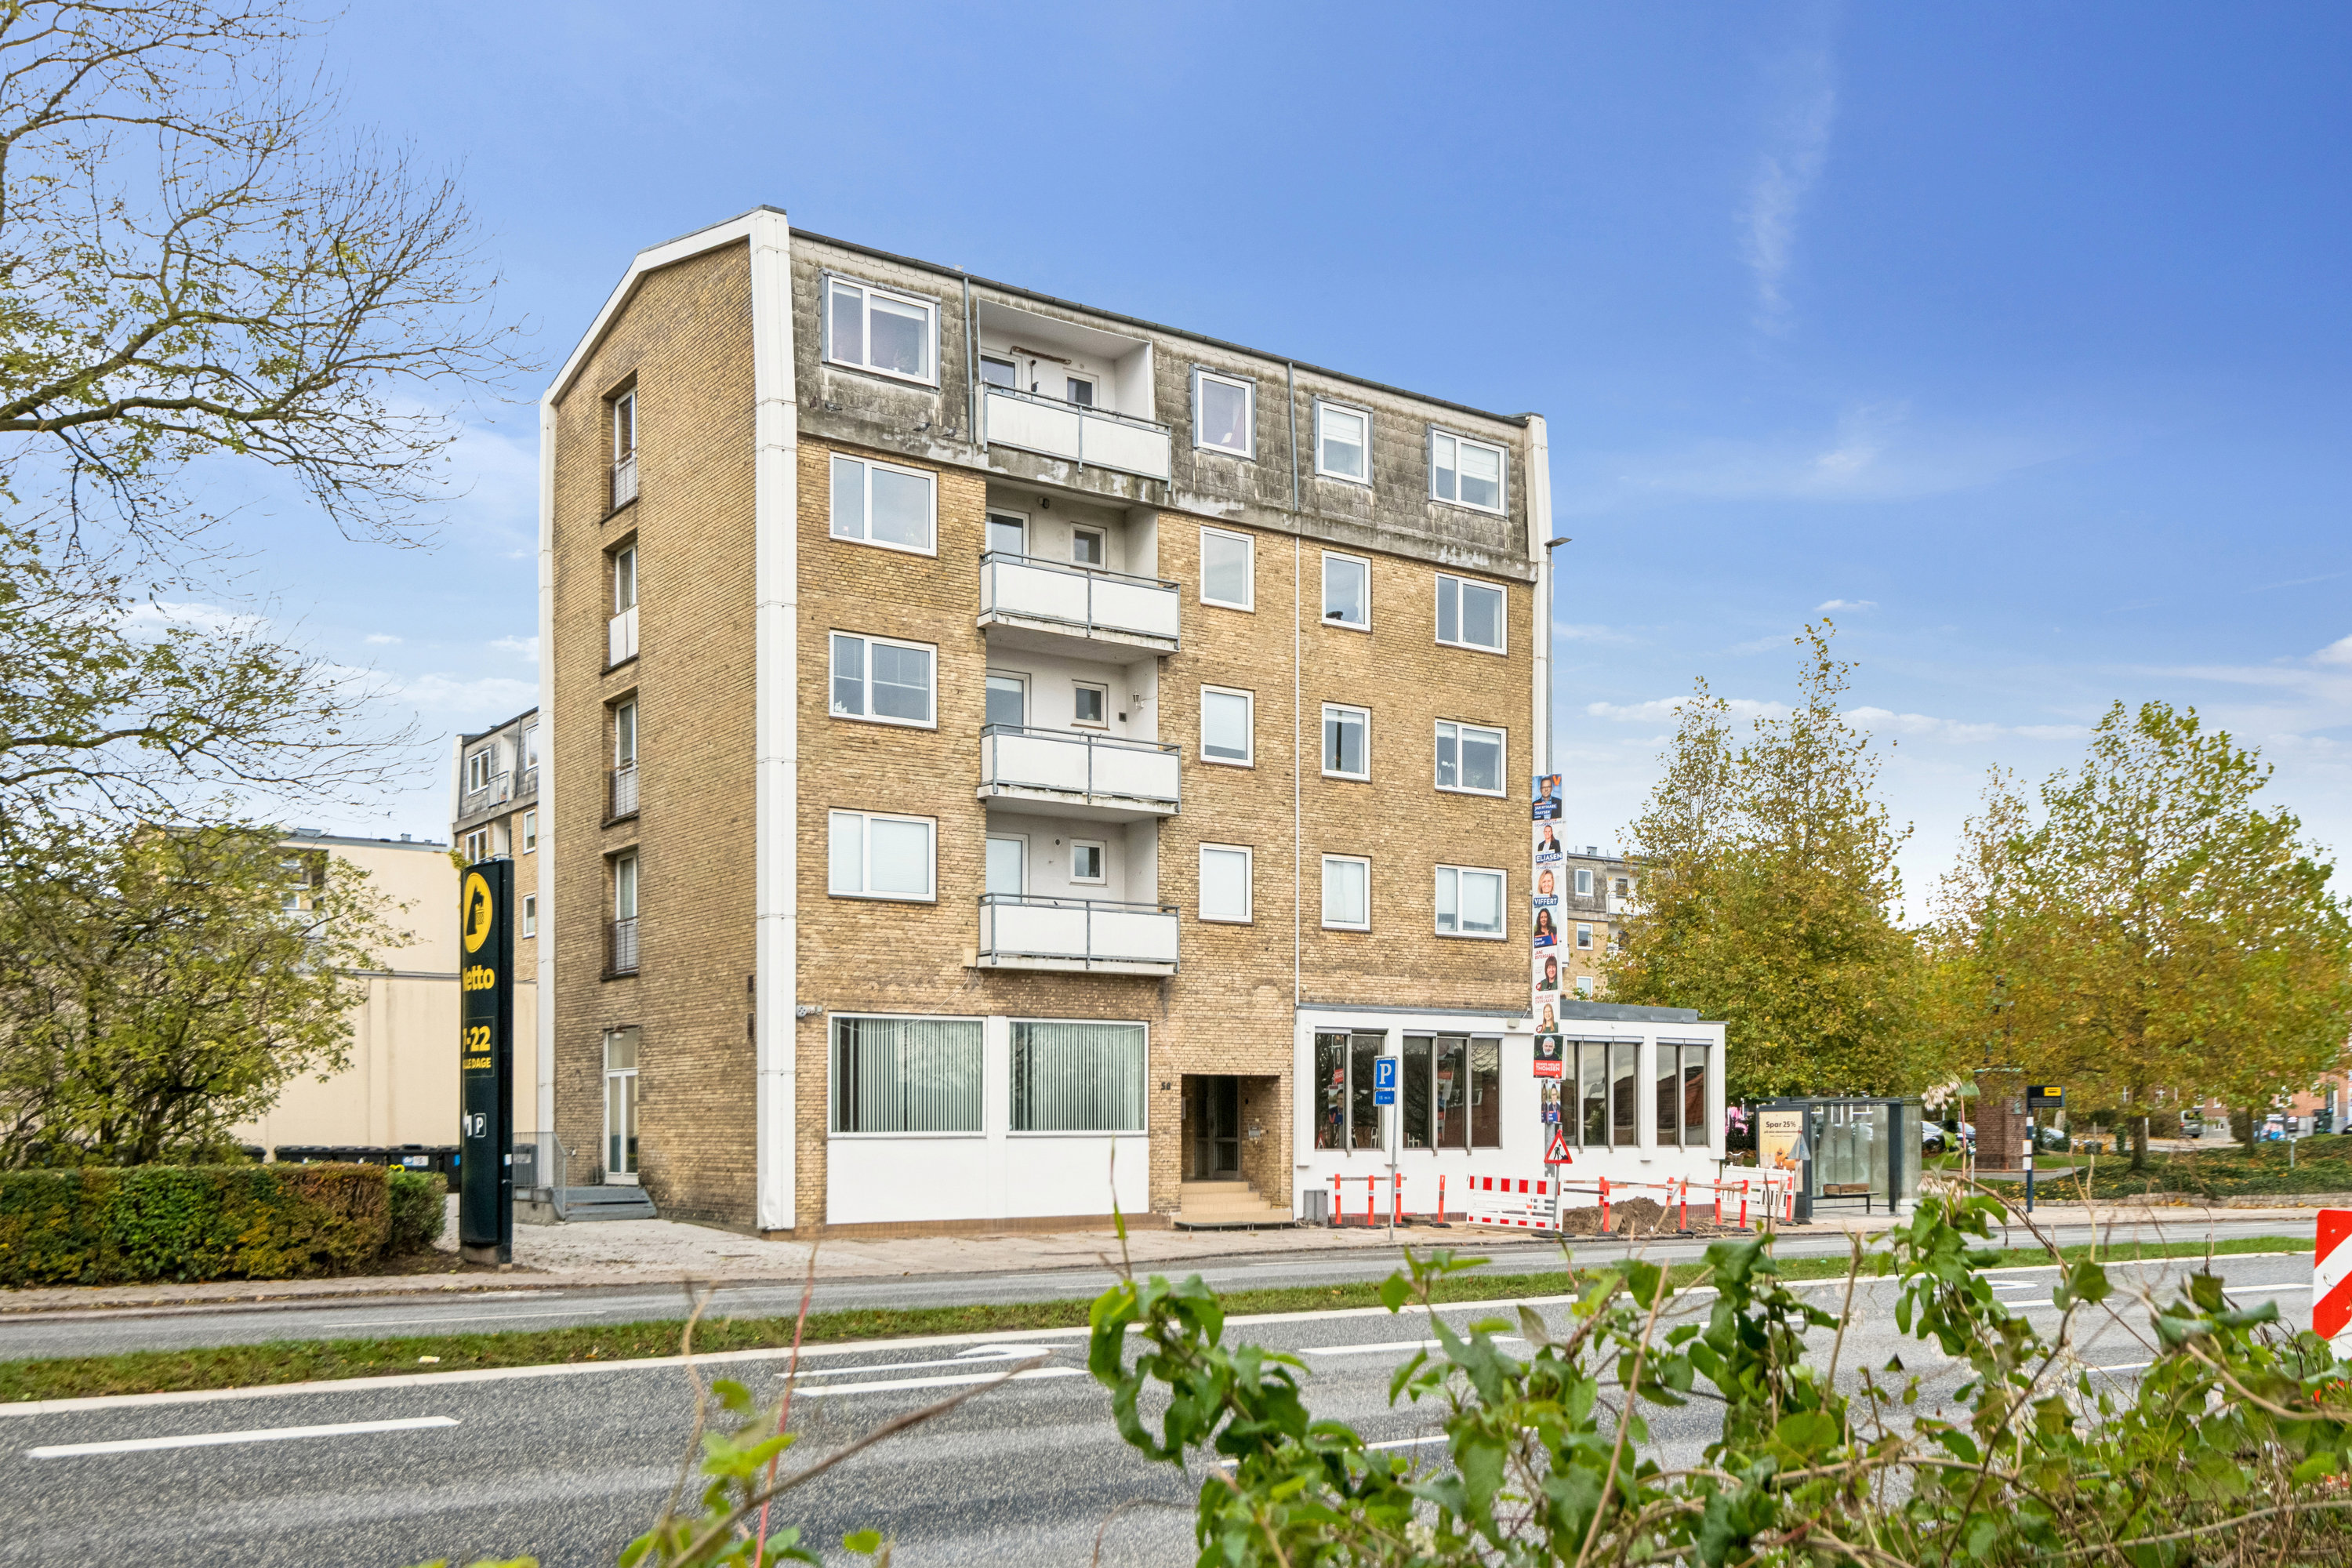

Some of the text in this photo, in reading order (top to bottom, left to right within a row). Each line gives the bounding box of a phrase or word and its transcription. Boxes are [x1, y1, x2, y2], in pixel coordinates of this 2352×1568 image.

[1552, 775, 1562, 786] V
[1536, 853, 1563, 862] ELIASEN
[471, 1057, 492, 1069] DAGE
[1379, 1063, 1392, 1084] P
[476, 1116, 484, 1134] P
